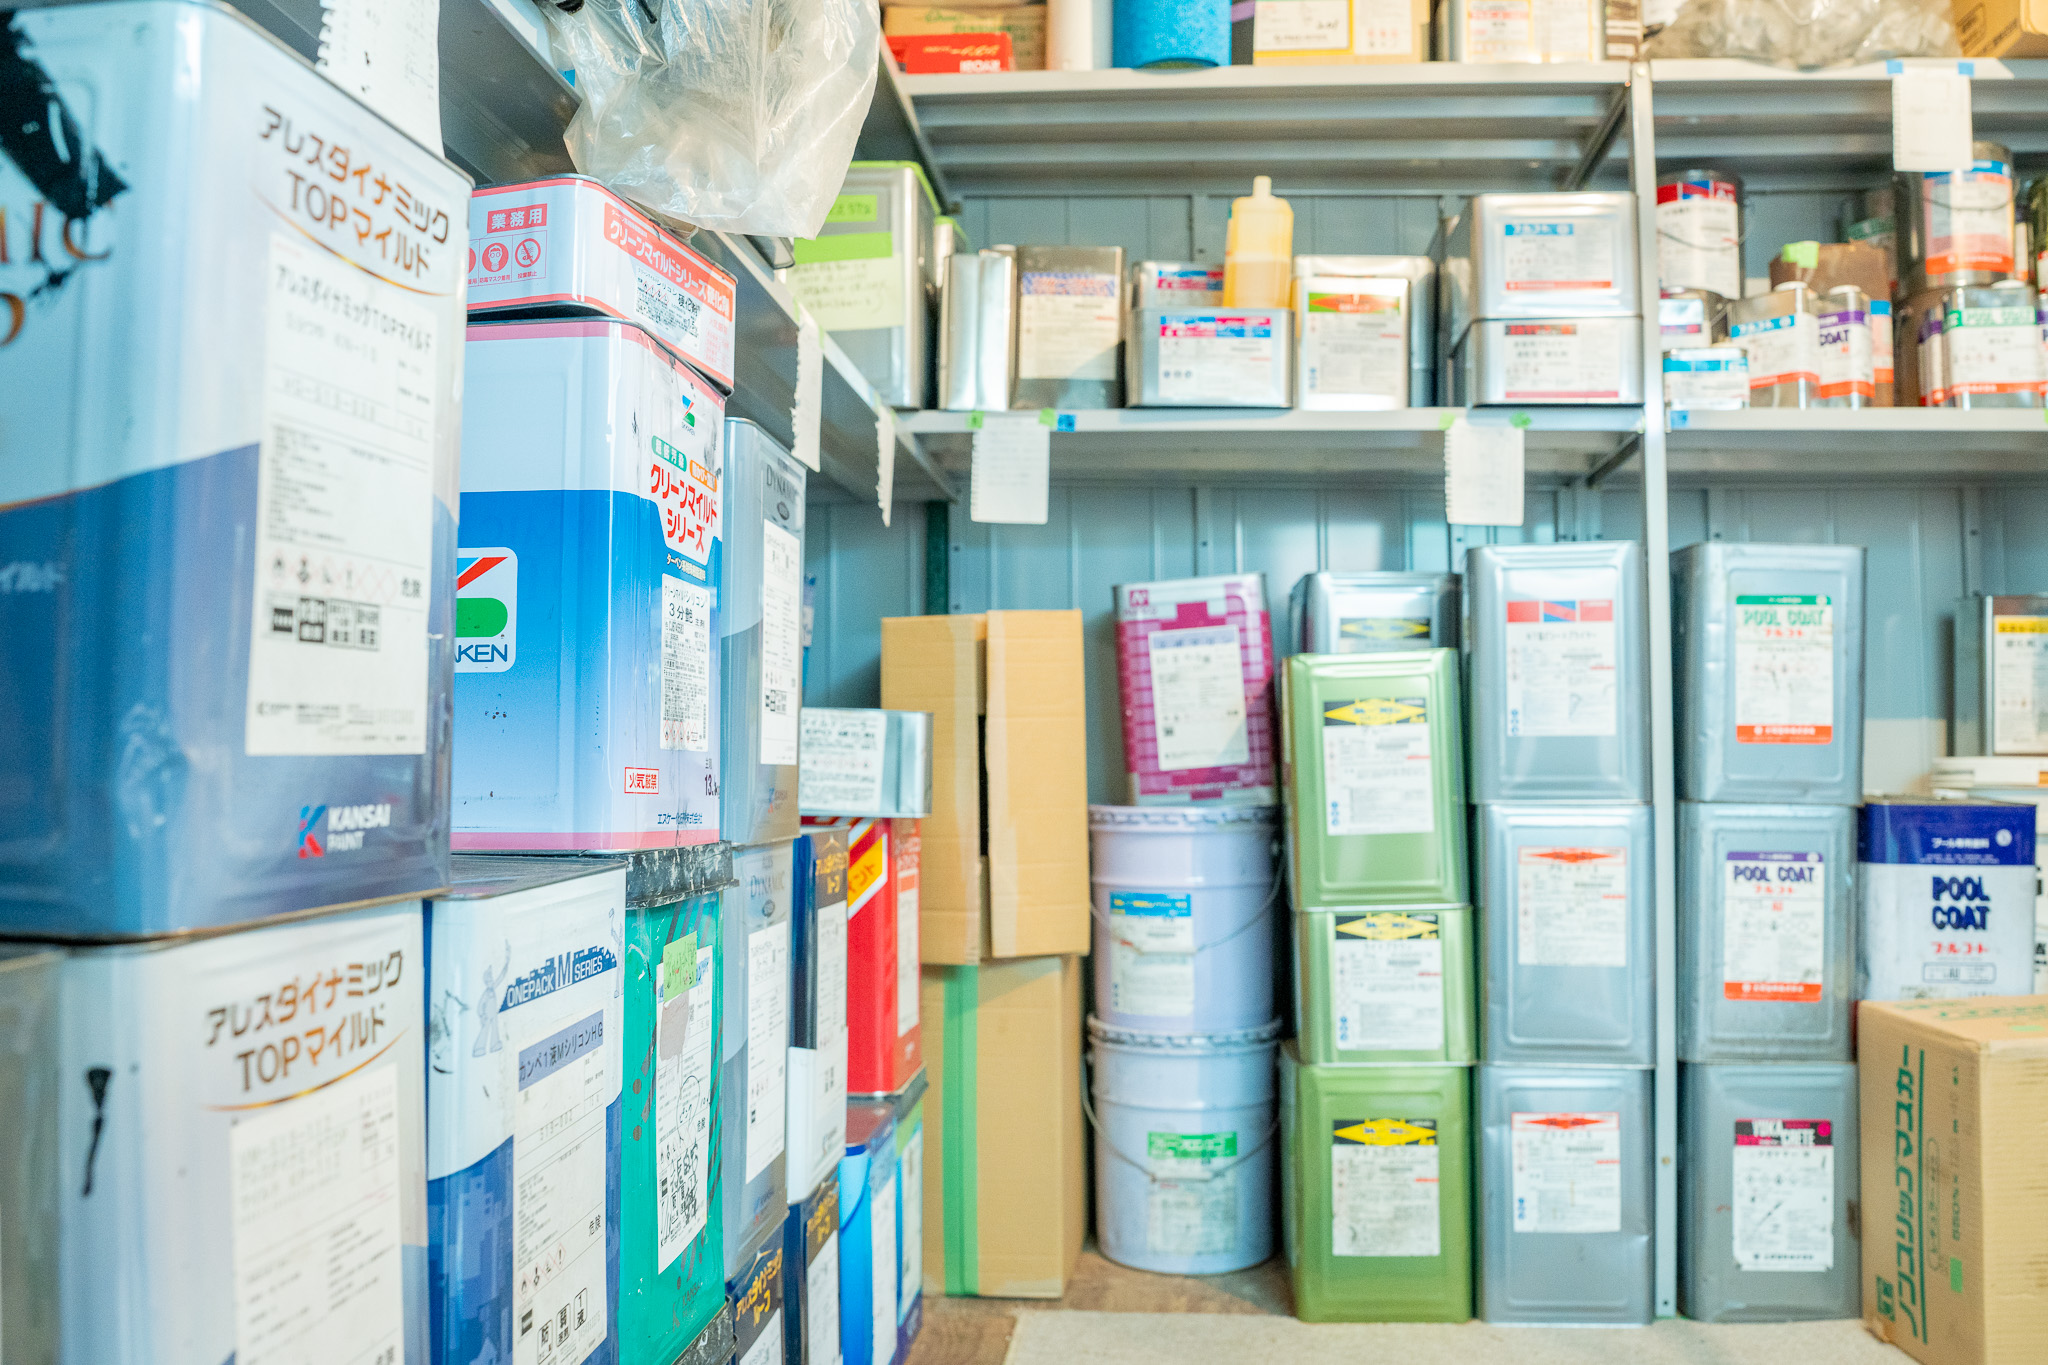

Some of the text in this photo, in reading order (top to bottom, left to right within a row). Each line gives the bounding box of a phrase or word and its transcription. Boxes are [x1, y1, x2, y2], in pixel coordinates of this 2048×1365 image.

[258, 106, 450, 245] アレスダイナミック
[286, 169, 430, 279] TOPマイルド
[491, 207, 543, 230] 業務用
[650, 463, 718, 529] クリーンマイルド
[667, 508, 706, 553] シリーズ
[454, 643, 508, 663] KEN
[629, 772, 657, 790] 火気厳禁
[328, 803, 391, 828] KANSAI
[327, 830, 365, 851] PAINT
[1733, 864, 1815, 883] POOL COAT
[1931, 875, 1991, 901] POOL
[1931, 906, 1991, 931] COAT
[507, 971, 555, 1008] ONEPACK
[557, 951, 572, 989] M
[574, 958, 604, 982] SERIES
[205, 951, 404, 1047] アレスダイナミック
[235, 1003, 387, 1092] TOPマイルド
